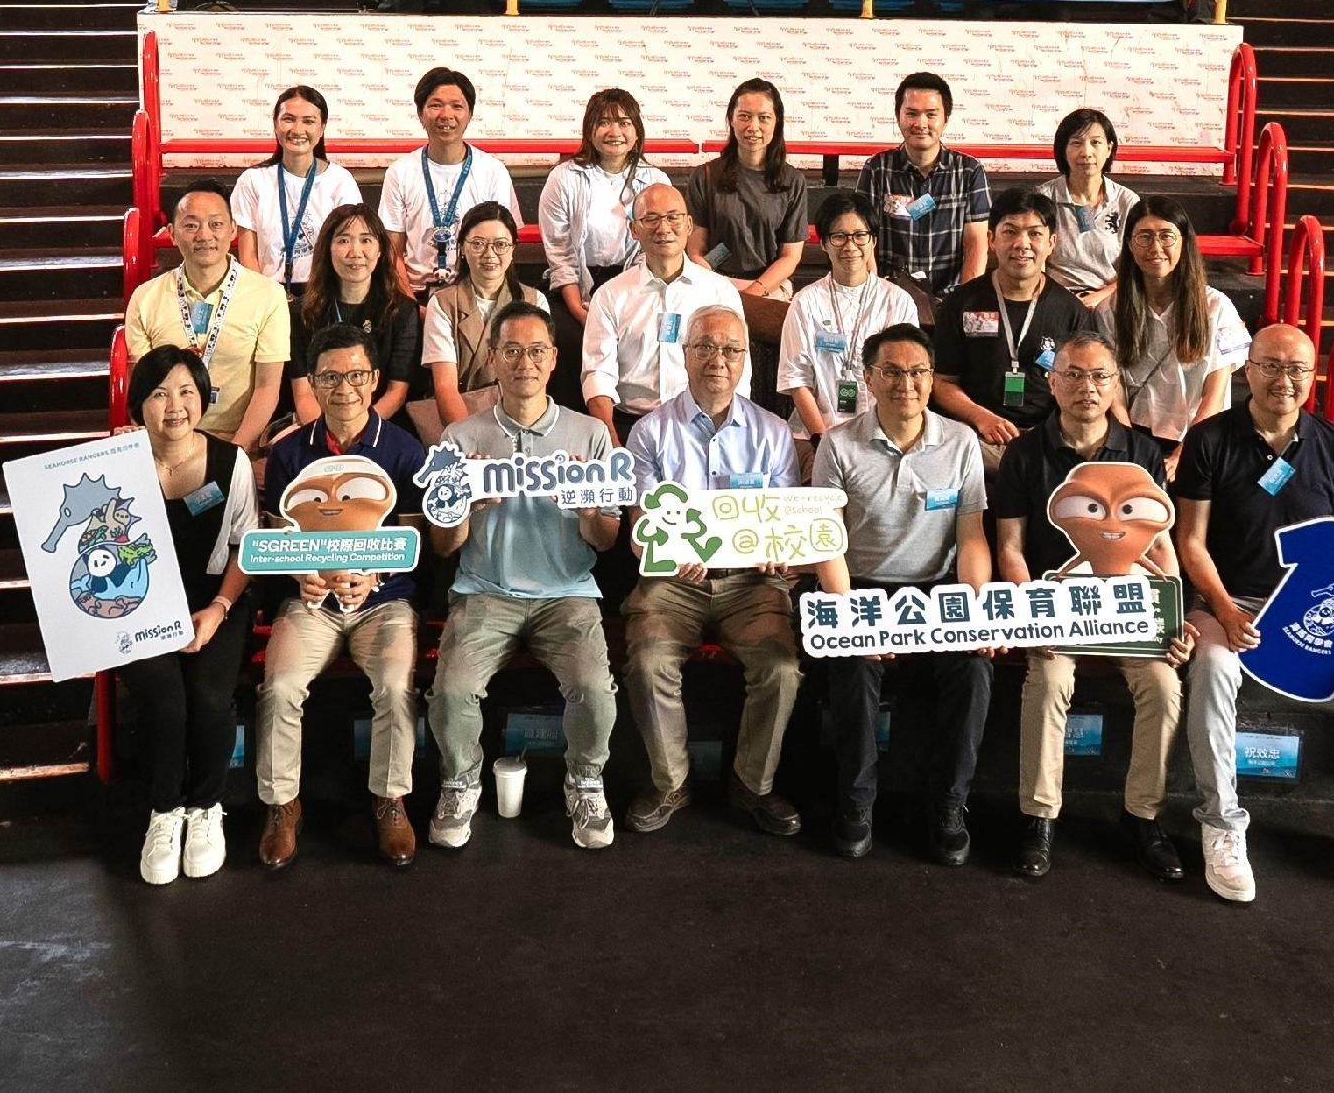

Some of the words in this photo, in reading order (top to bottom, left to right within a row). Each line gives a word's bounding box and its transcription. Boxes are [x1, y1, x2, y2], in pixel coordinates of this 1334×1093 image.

[610, 451, 634, 482] R
[560, 486, 634, 505] 逆瀕行動
[711, 494, 781, 524] 回收
[732, 517, 844, 562] @校園
[250, 554, 304, 564] Inter-school
[305, 553, 348, 564] Recycling
[349, 552, 406, 562] Competition
[807, 582, 1147, 629] 海洋公園保育聯盟
[173, 620, 183, 631] R
[810, 633, 877, 651] Ocean
[879, 628, 925, 647] Park
[930, 623, 1063, 645] Conservation
[1069, 619, 1149, 638] Alliance
